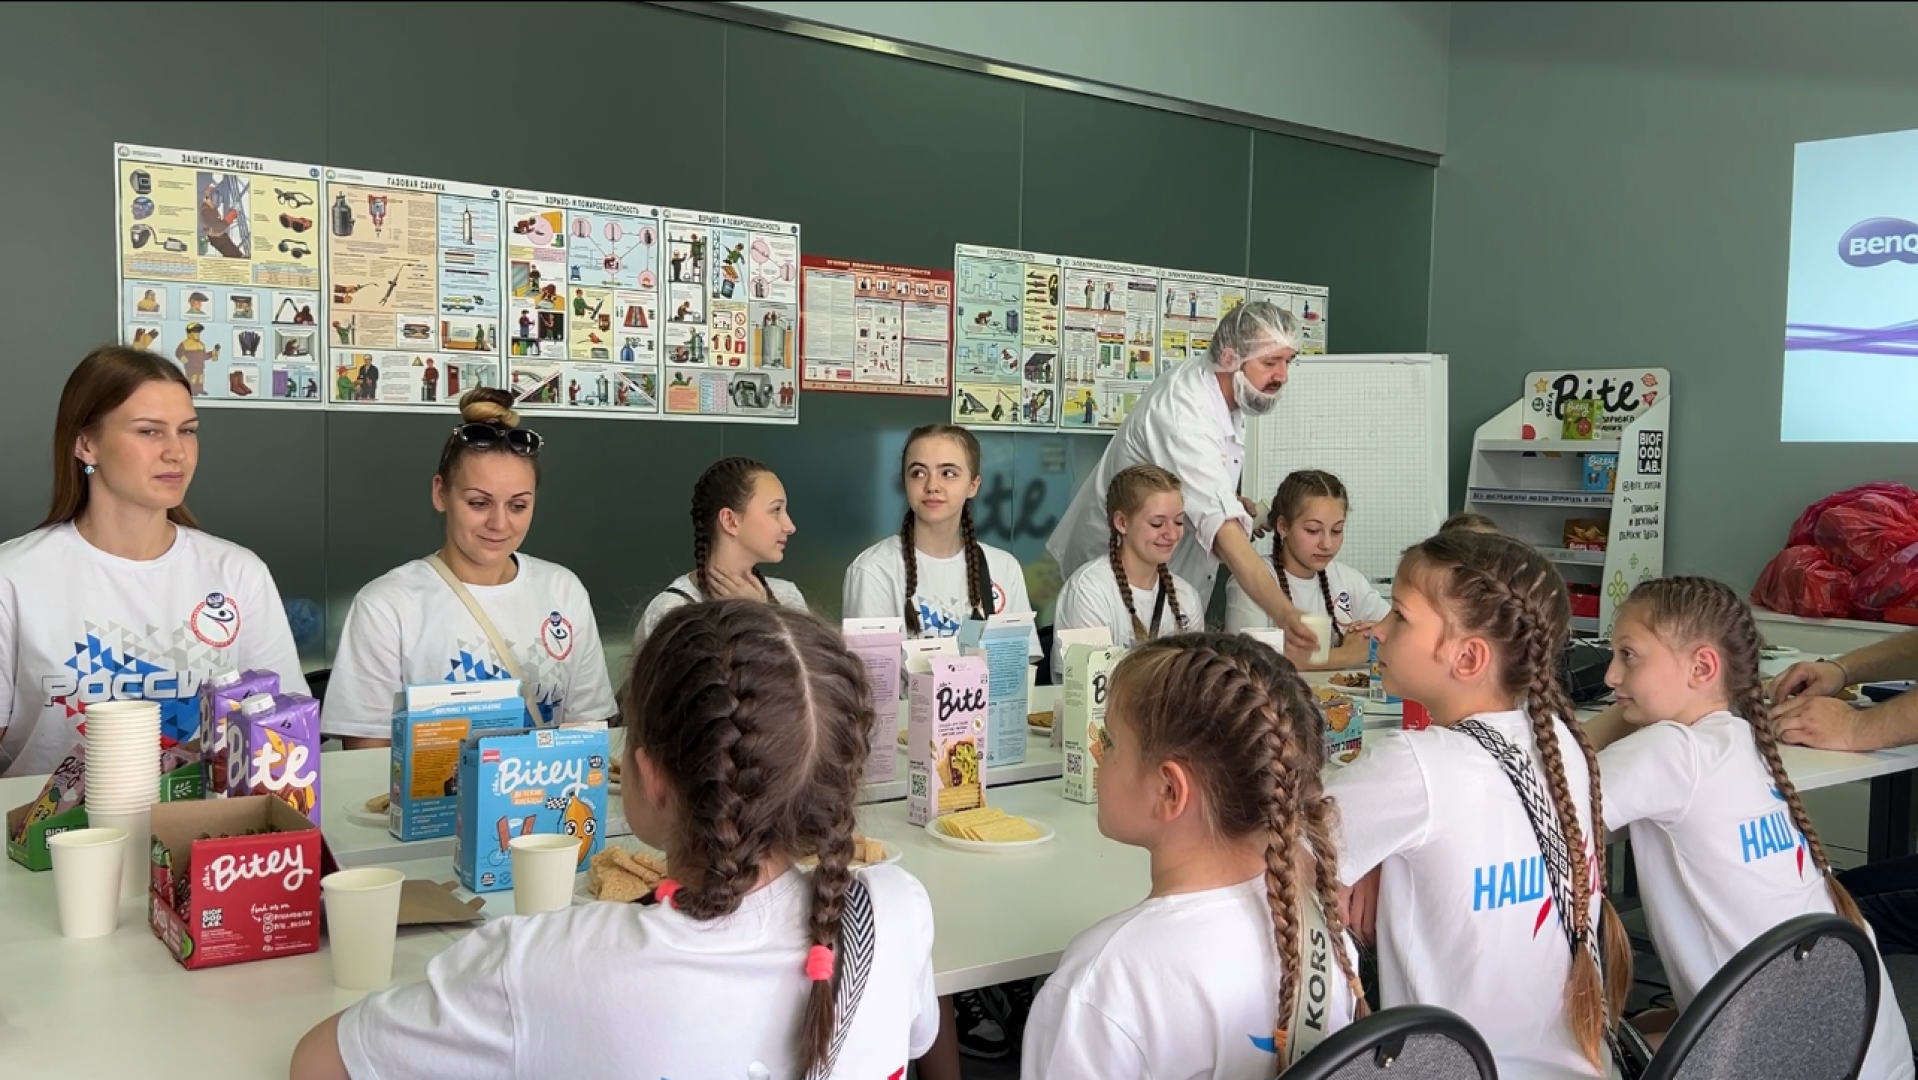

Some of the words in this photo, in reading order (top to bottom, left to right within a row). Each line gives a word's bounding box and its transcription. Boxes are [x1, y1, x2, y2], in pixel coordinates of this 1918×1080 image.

[181, 153, 224, 167] ЗАЩИТНЫЕ
[226, 158, 264, 171] СРЕДСТВА
[387, 177, 418, 188] ГАЗОВАЯ
[420, 181, 446, 191] СВАРКА
[1639, 432, 1662, 445] BIOF
[1639, 446, 1662, 459] OOD
[1639, 460, 1661, 473] LAB.
[41, 667, 213, 707] РОССИ
[936, 687, 986, 721] Bite
[228, 724, 317, 790] Bite
[498, 757, 589, 800] Bitey
[1739, 810, 1795, 863] НАШ
[211, 844, 313, 892] Bitey
[1474, 855, 1544, 912] НАШ
[1305, 928, 1326, 1032] KORS
